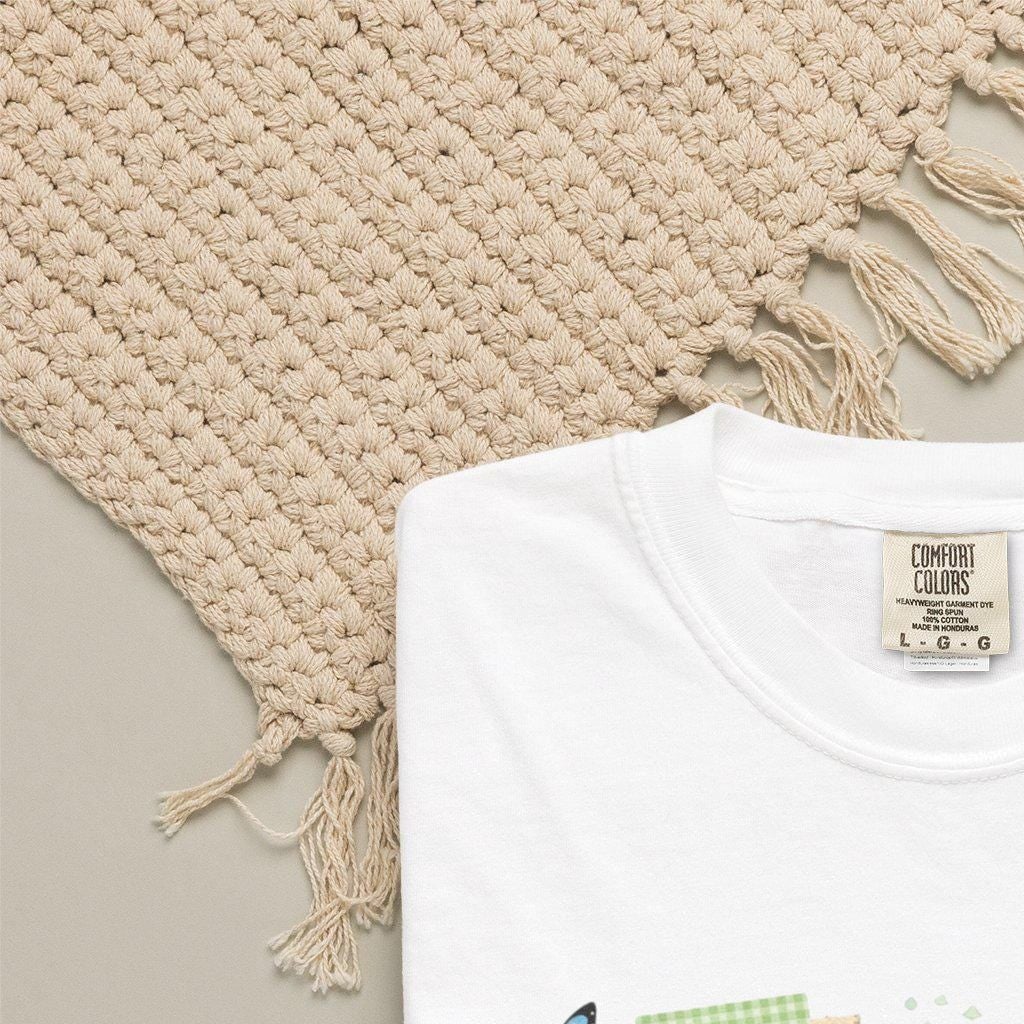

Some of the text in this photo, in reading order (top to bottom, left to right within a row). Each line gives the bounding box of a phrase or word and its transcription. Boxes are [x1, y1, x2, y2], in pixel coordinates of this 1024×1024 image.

[911, 543, 976, 568] COMFORT
[895, 597, 994, 609] HEAVYWEIGHT GARMENT DYE
[926, 608, 964, 616] RING SPUN
[922, 616, 940, 624] 100%
[911, 623, 932, 631] MADE
[933, 624, 940, 632] IN
[899, 632, 911, 648] L
[936, 635, 951, 650] G
[977, 635, 991, 651] G
